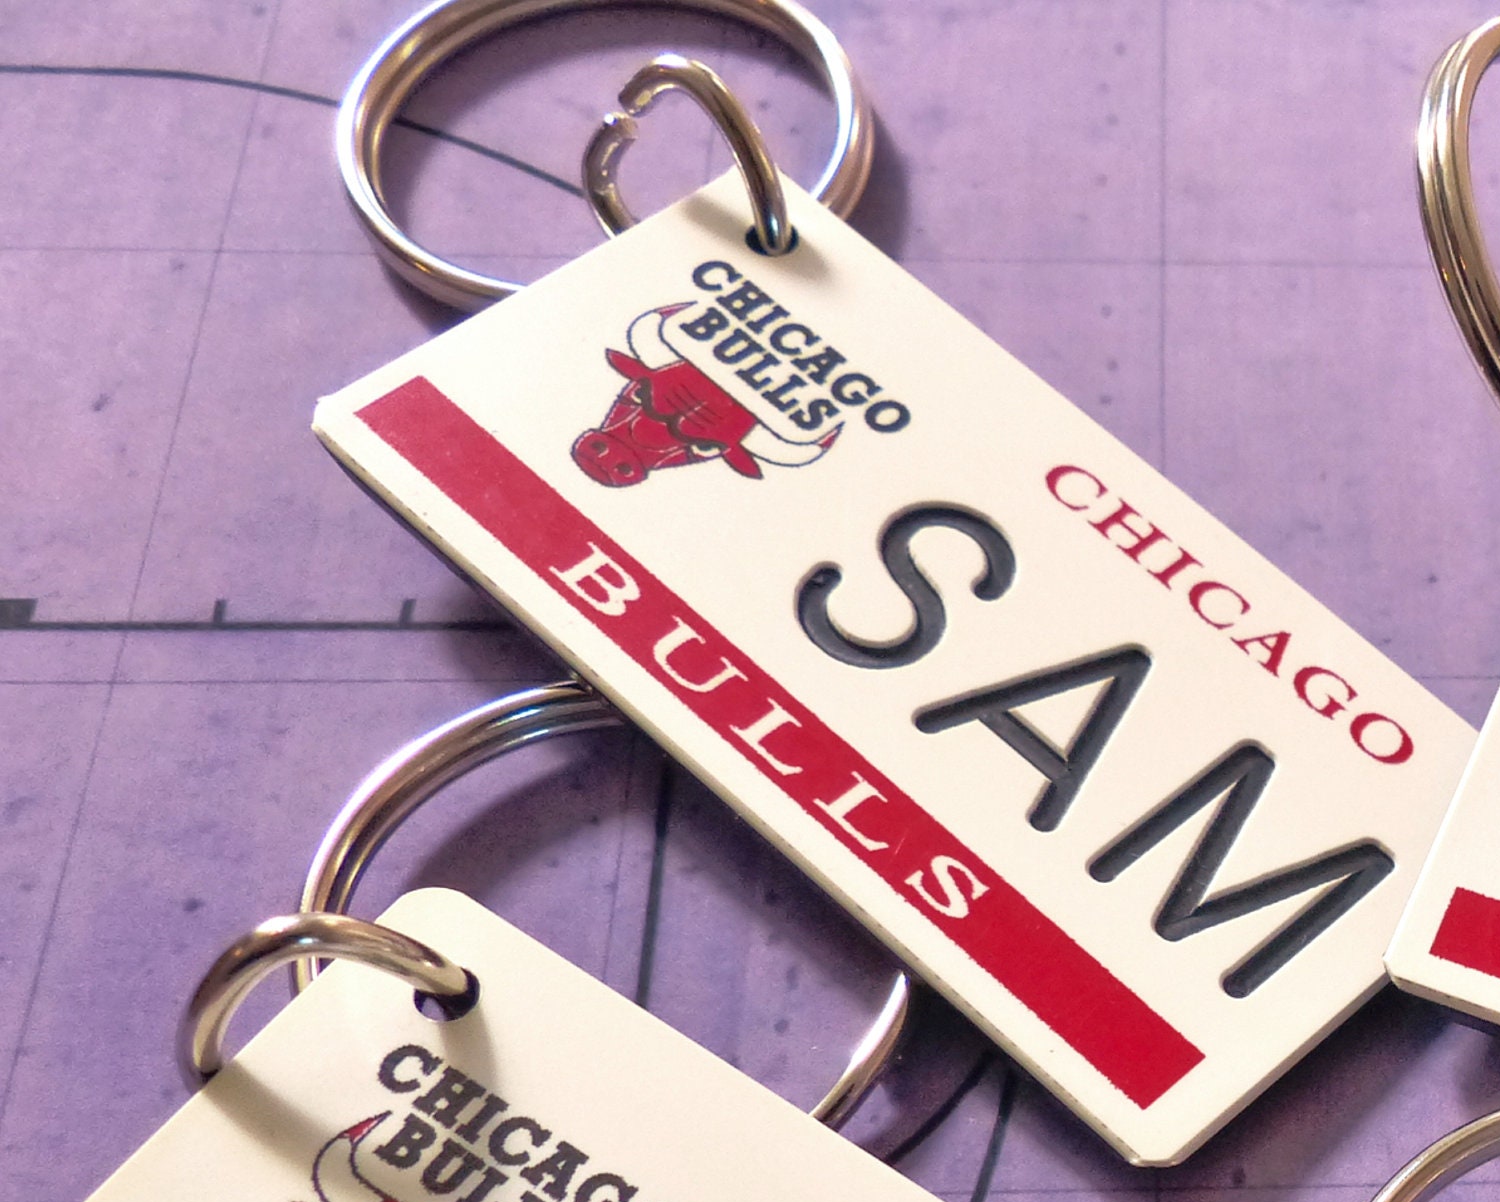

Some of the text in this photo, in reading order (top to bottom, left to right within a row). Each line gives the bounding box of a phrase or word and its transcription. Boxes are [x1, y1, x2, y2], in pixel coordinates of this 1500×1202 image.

[682, 308, 840, 431] BULLS
[693, 262, 910, 432] CHICAGO
[548, 541, 989, 920] BULLS
[795, 500, 1397, 999] SAM
[1044, 464, 1415, 767] CHICAGO
